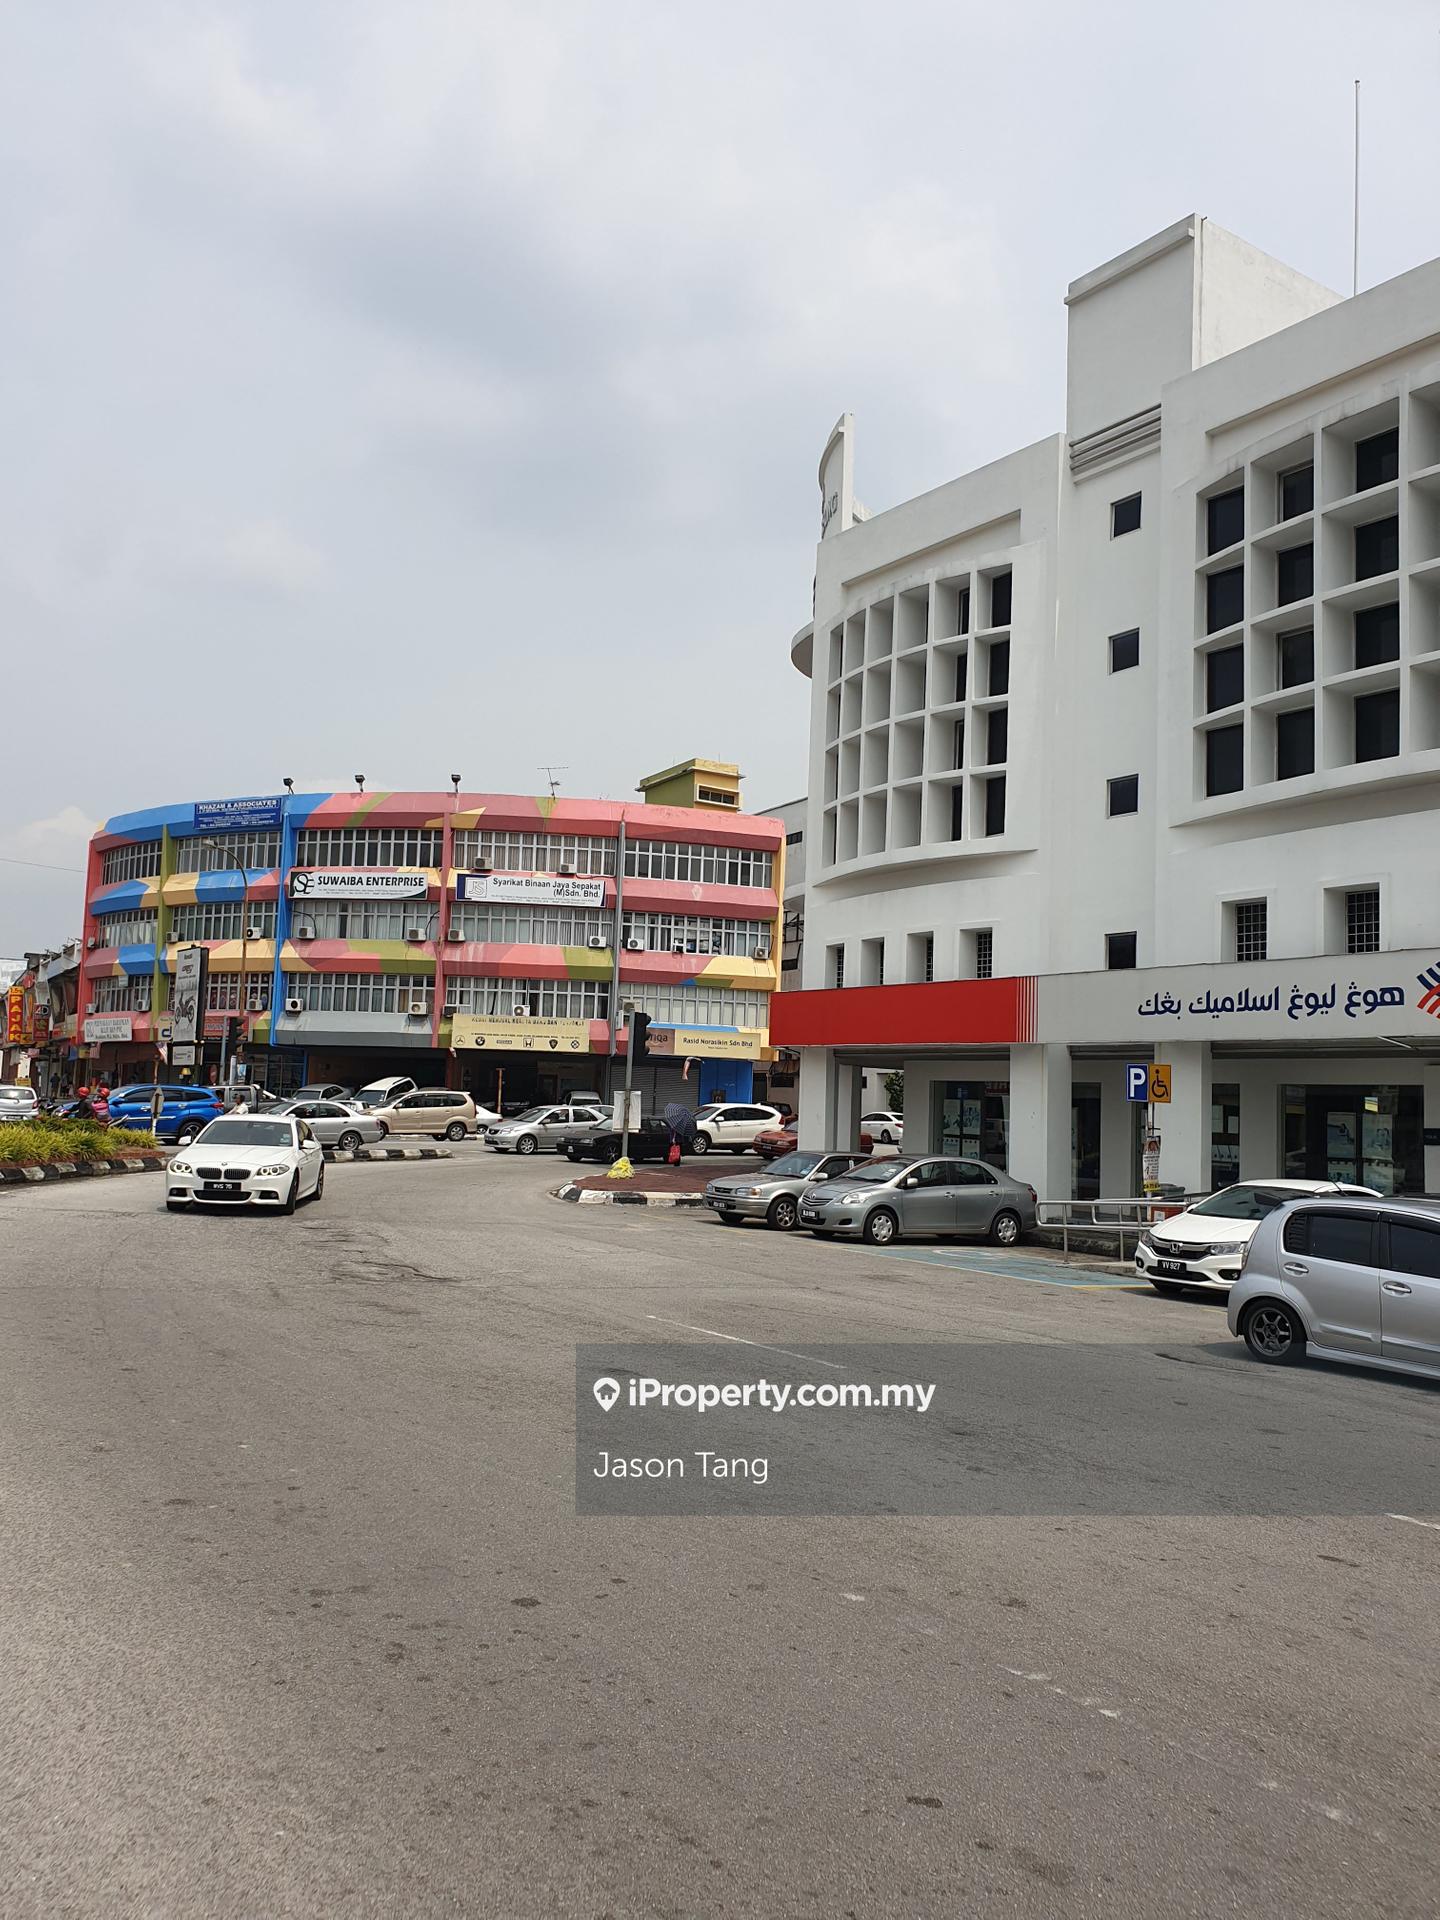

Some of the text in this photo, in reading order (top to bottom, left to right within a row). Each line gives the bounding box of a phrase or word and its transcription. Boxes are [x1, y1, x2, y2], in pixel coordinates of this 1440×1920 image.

[233, 799, 277, 808] ASSOCIATES
[317, 875, 425, 887] SUWAIBA ENTERPRISE
[493, 877, 601, 892] Syarikat Binaan Jaya Sepakat
[583, 890, 600, 898] Bhd.
[9, 995, 22, 1041] PAJAK
[729, 1039, 740, 1047] Sdn
[1130, 1068, 1146, 1098] P
[1170, 1262, 1180, 1270] 927
